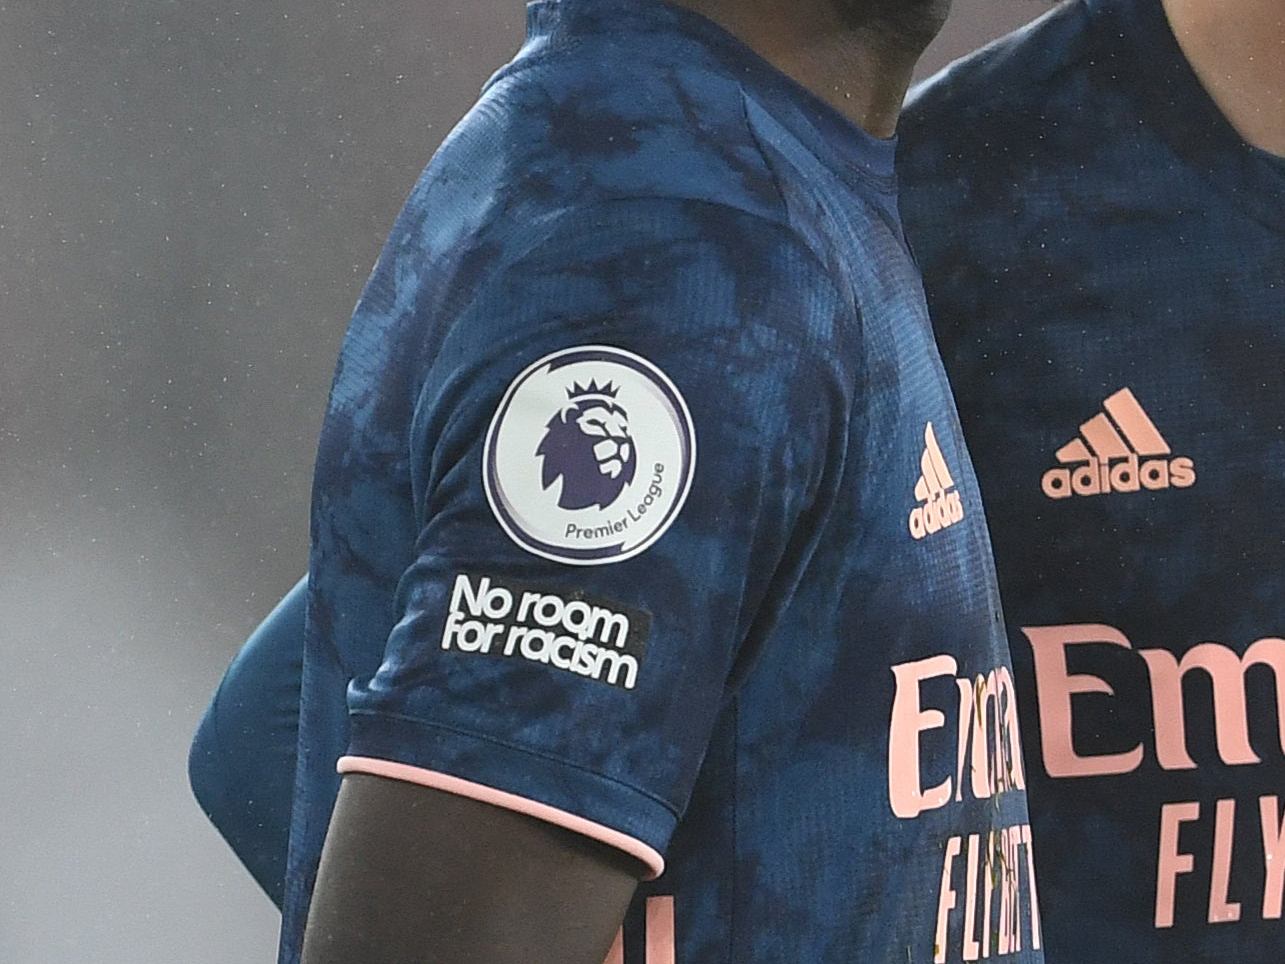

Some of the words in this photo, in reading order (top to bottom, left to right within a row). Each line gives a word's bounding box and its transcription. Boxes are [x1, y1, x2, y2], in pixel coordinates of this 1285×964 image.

[565, 521, 628, 539] Premier
[627, 463, 665, 522] League
[1041, 453, 1196, 499] adidas
[909, 488, 964, 540] adidas
[449, 574, 513, 619] No
[516, 591, 629, 648] room
[441, 610, 504, 653] for
[503, 625, 638, 689] racism
